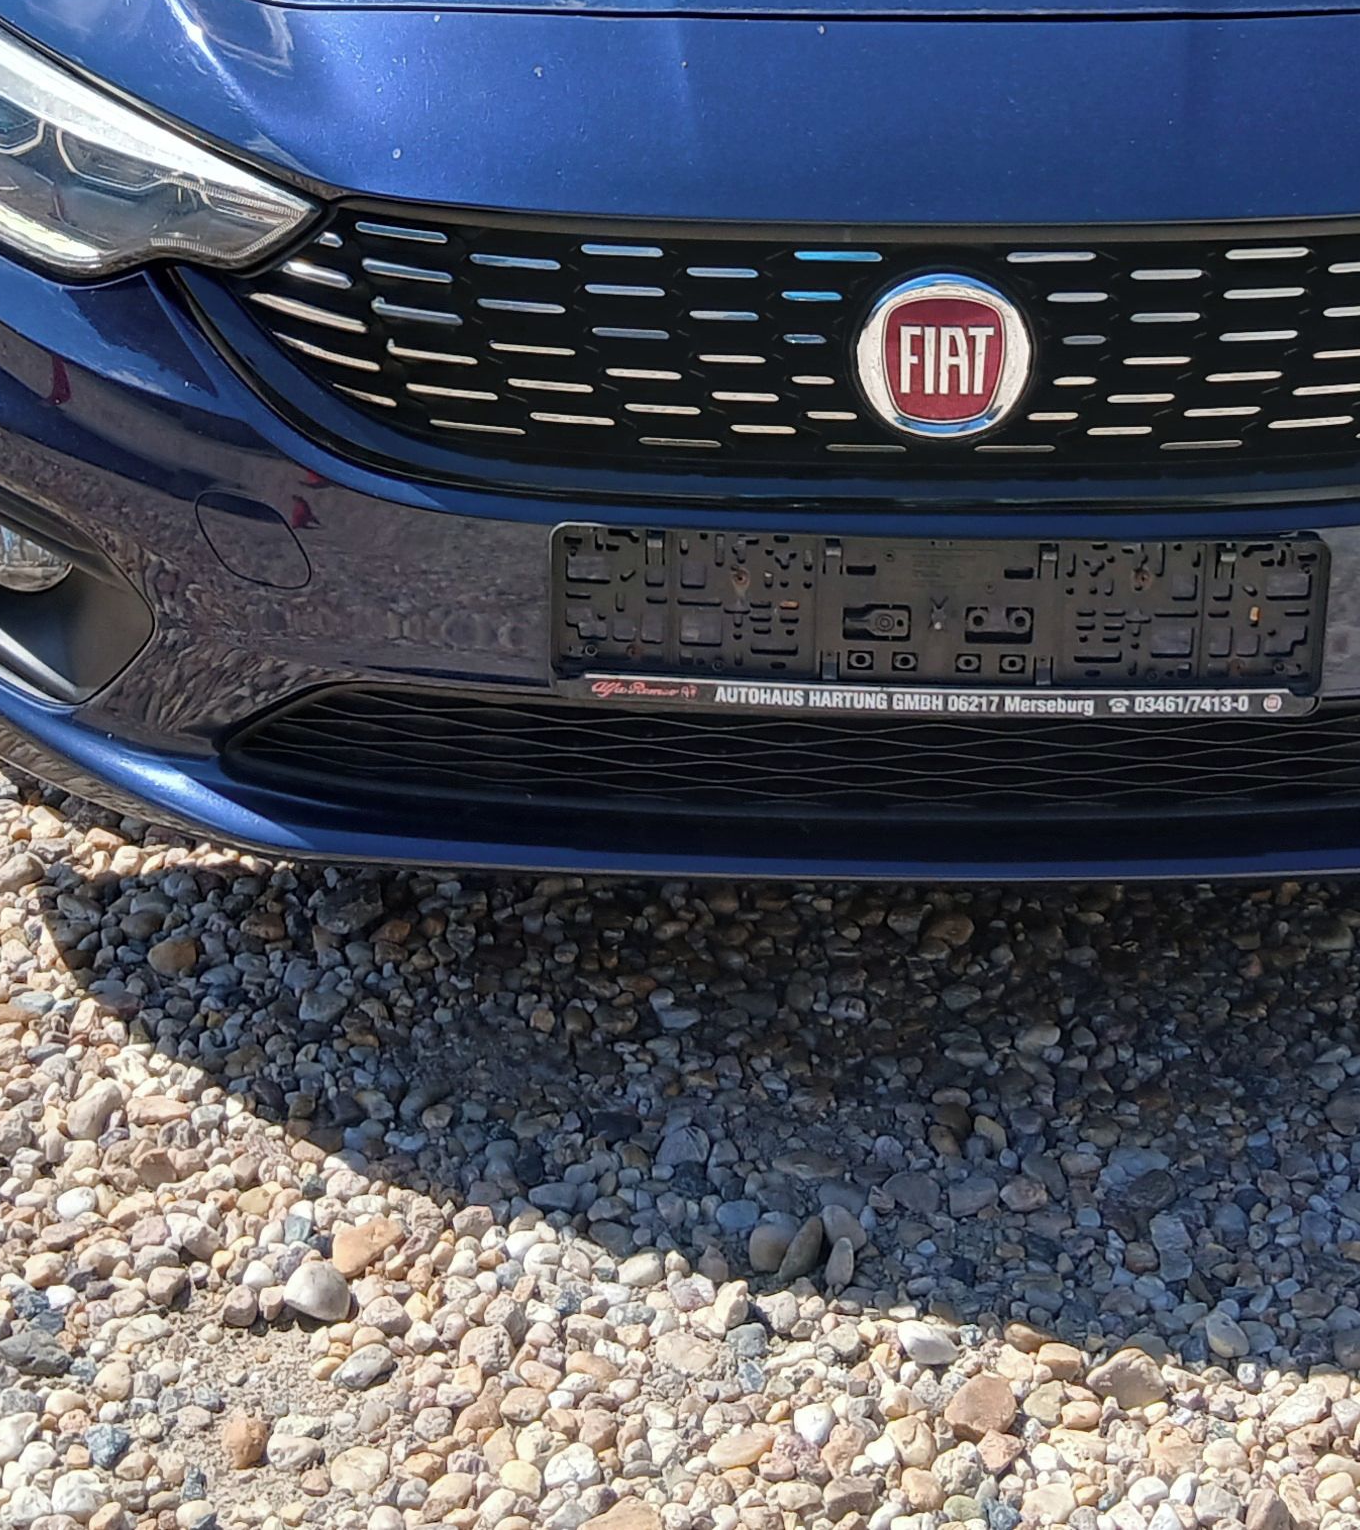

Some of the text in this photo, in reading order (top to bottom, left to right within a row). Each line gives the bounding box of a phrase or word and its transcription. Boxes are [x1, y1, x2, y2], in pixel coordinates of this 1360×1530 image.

[900, 325, 994, 395] FIAT
[591, 680, 680, 698] Alfa Romeo
[715, 686, 804, 707] AUTOHAUS
[809, 690, 889, 710] HARTUNG
[892, 693, 944, 712] GMBH
[947, 694, 999, 712] 06217
[1004, 696, 1094, 716] Merseburg
[1134, 695, 1249, 714] 03461/7413-0
